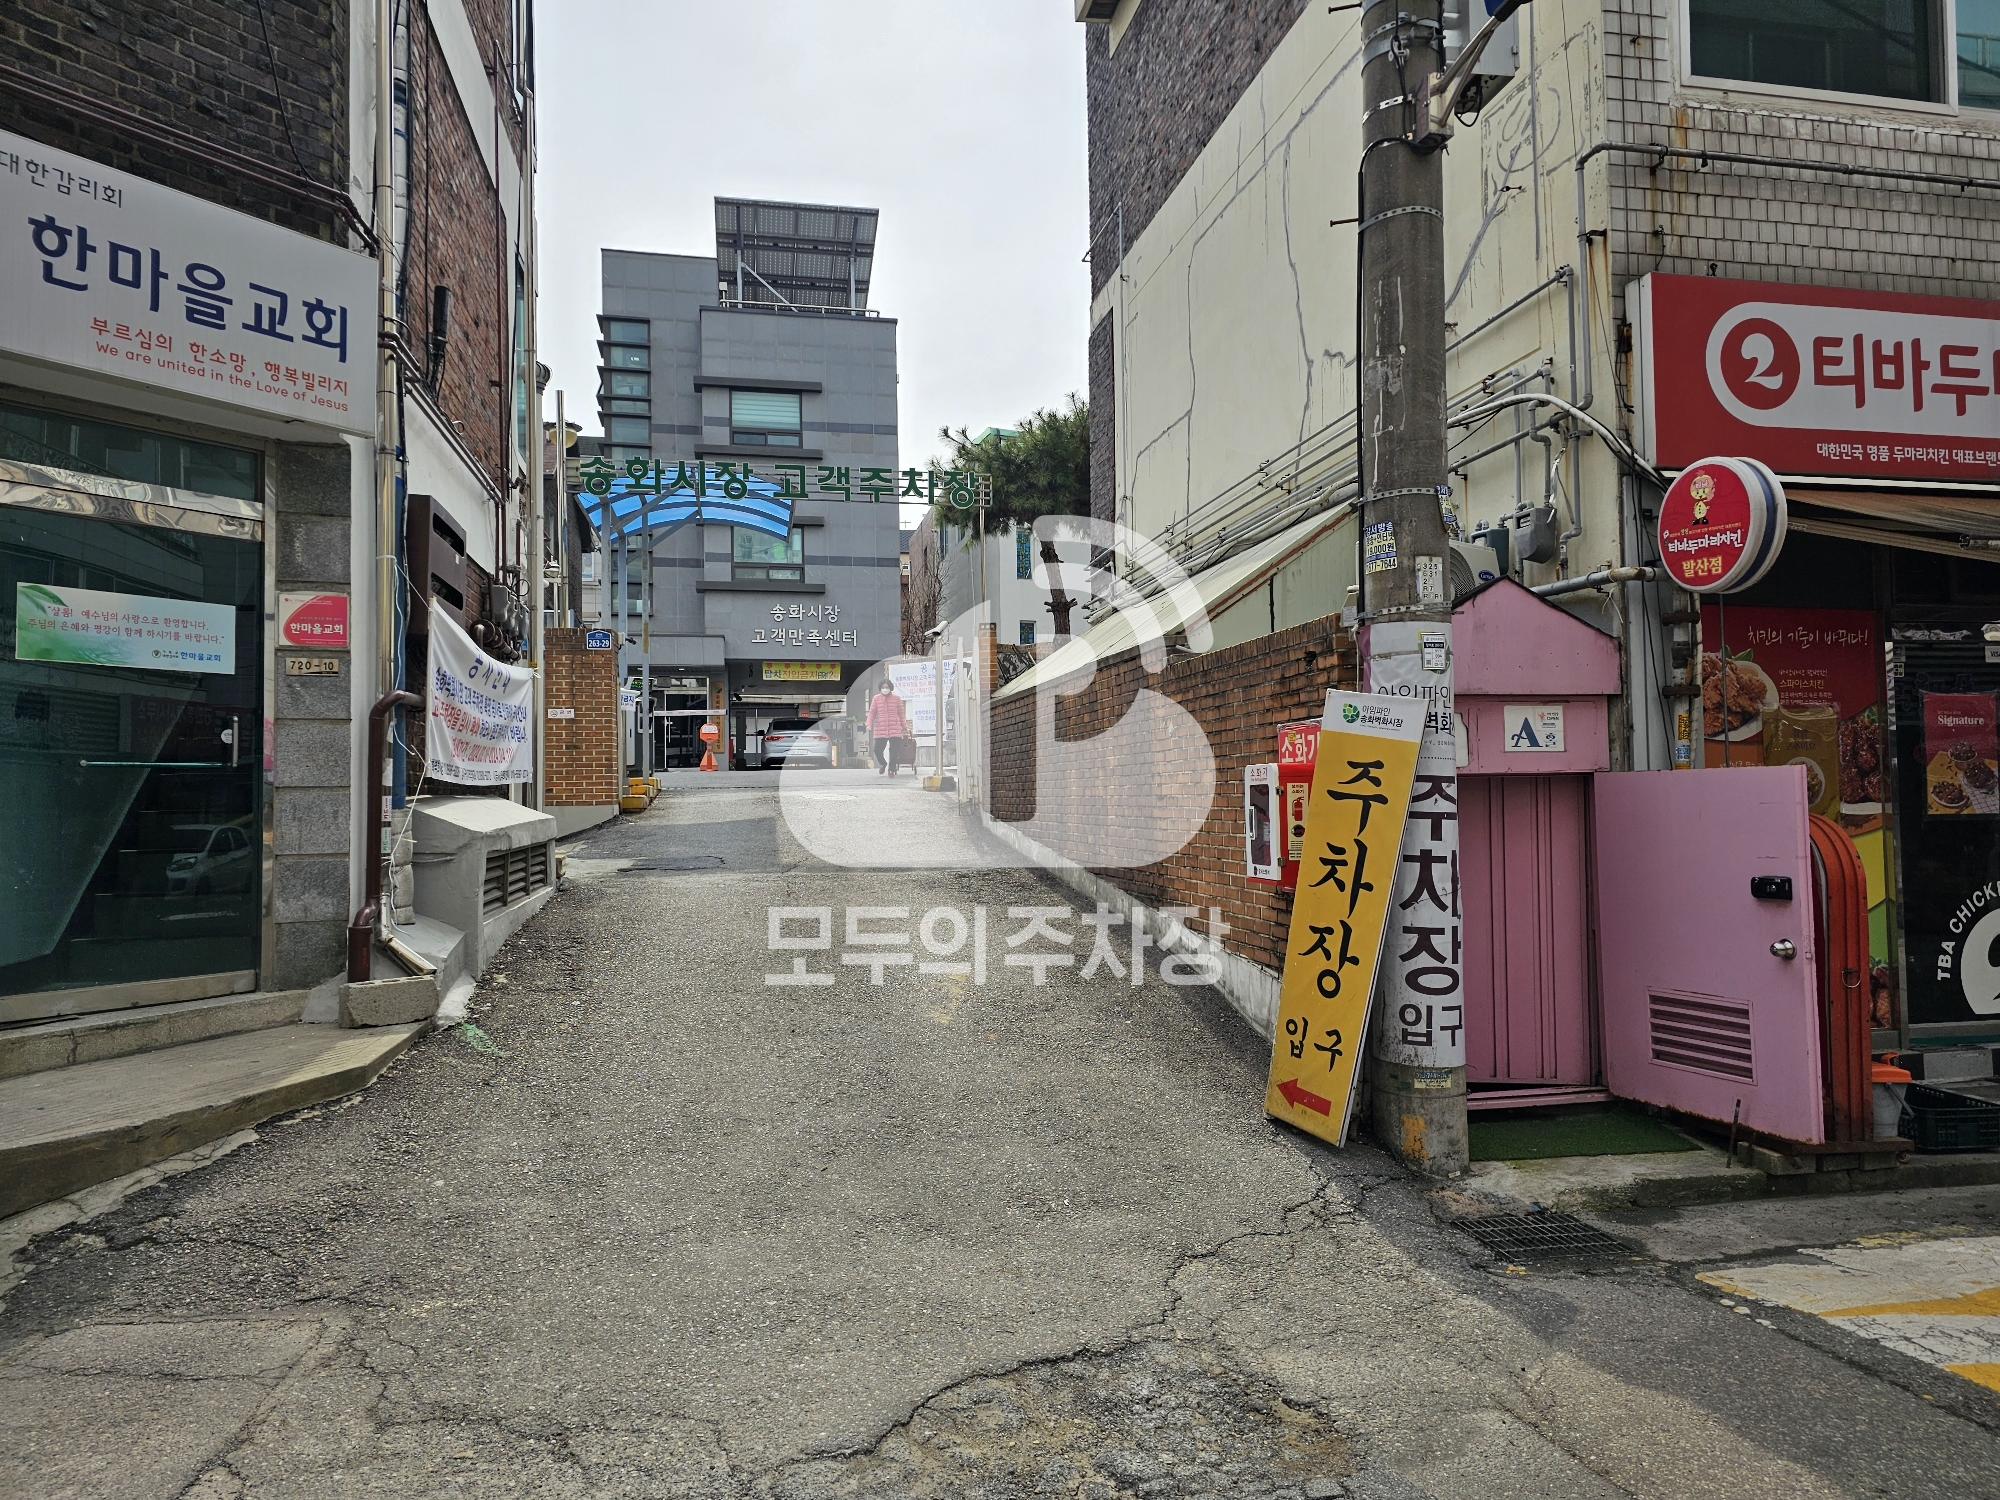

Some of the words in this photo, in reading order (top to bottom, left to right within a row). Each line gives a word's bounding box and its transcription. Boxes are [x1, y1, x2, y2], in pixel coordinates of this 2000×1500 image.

[27, 213, 348, 363] 한마을교회
[90, 317, 172, 353] 부르심의
[189, 341, 256, 377] 한소망,
[264, 360, 347, 396] 행복빌리지
[96, 341, 119, 357] We
[125, 350, 152, 364] are
[157, 357, 206, 377] united
[210, 369, 224, 381] in
[229, 373, 252, 388] the
[256, 381, 289, 397] Love
[293, 391, 307, 401] of
[310, 394, 349, 412] Jesus
[1816, 443, 1864, 460] 대한민국
[1867, 445, 1890, 462] 명품
[1893, 446, 1950, 464] 두마리치킨
[579, 456, 753, 500] 송화시장
[773, 463, 980, 510] 고객주차장
[1668, 529, 1743, 554] 티바두마리치킨
[1683, 556, 1722, 578] 발산점
[81, 610, 118, 622] 예수님의
[122, 613, 160, 625] 사랑으로
[770, 603, 841, 623] 송화시장
[27, 618, 56, 630] 주님의
[60, 620, 90, 632] 은혜와
[94, 624, 121, 636] 평강이
[125, 627, 143, 638] 함께
[146, 630, 181, 641] 하시기를
[290, 623, 343, 635] 한마을교회
[751, 628, 858, 647] 고객만족센터
[1748, 625, 1782, 646] 치킨의
[1787, 626, 1819, 649] 기준이
[588, 640, 610, 648] 263-29
[180, 651, 222, 662] 한마을교회
[290, 661, 334, 671] 720-10
[1360, 715, 1404, 728] 송화벽화시장
[1362, 704, 1391, 717] 아임파인
[1937, 714, 1985, 727] Signature
[1297, 760, 1390, 999] 주차장
[1936, 940, 1956, 982] TBA
[1399, 1003, 1463, 1047] 입구
[1285, 1016, 1344, 1073] 입구
